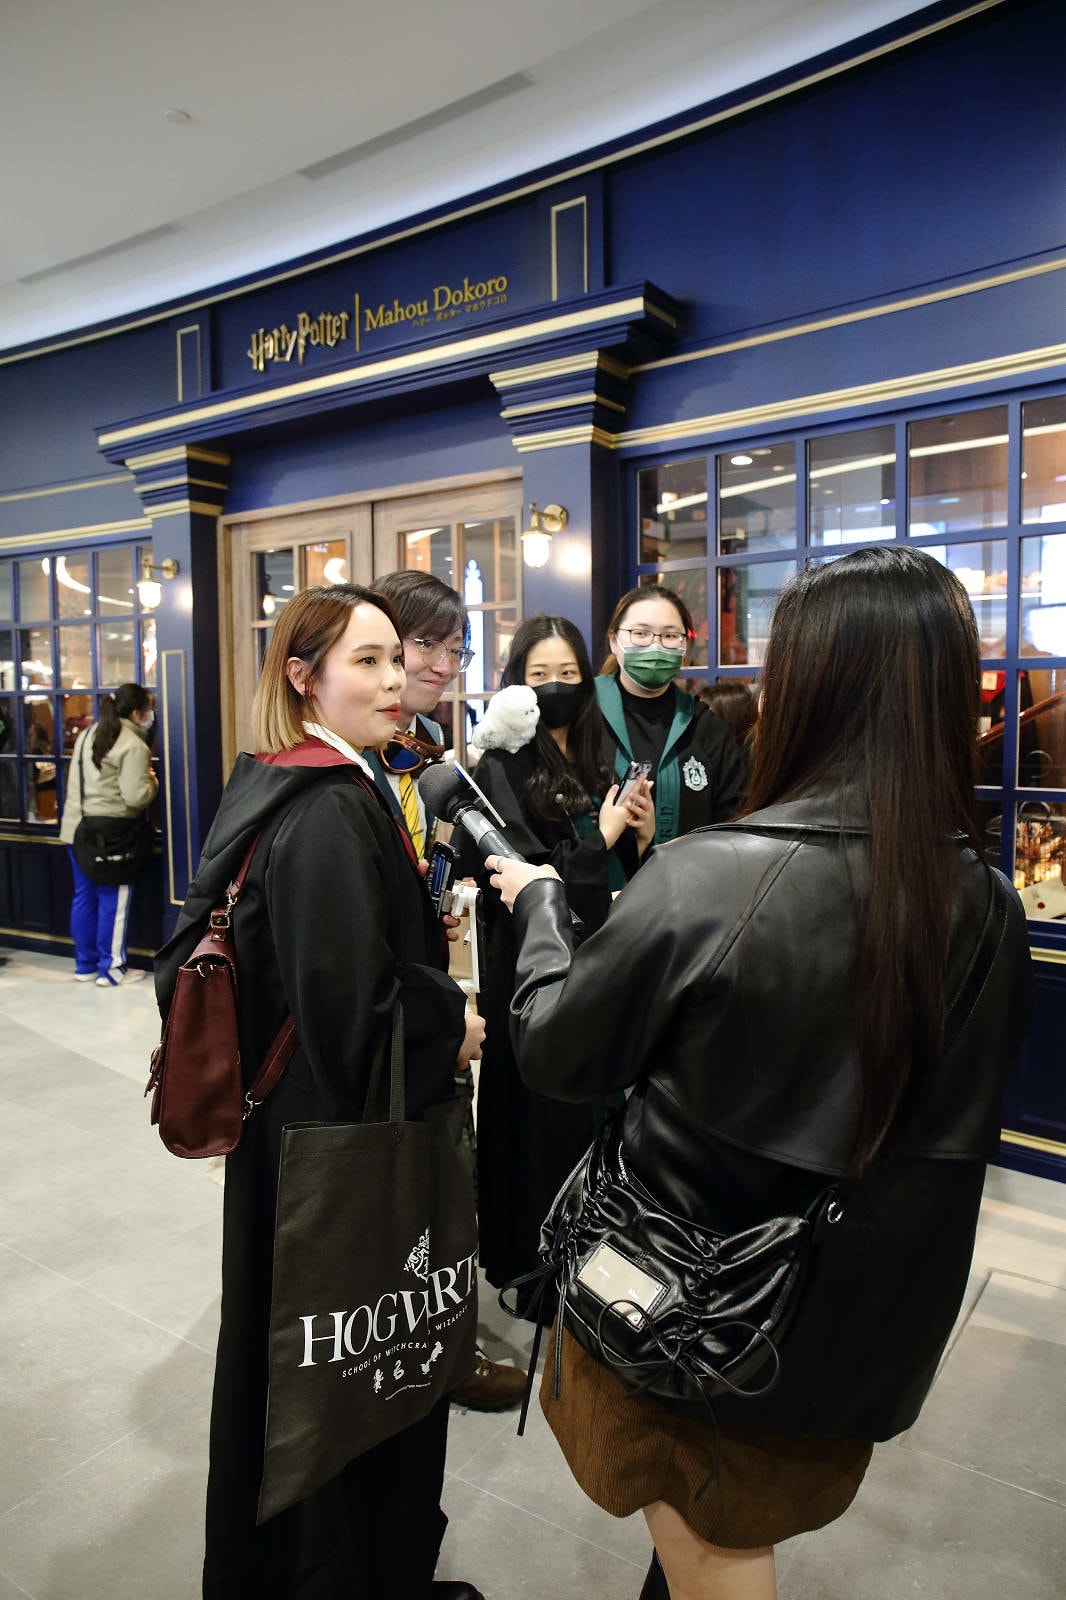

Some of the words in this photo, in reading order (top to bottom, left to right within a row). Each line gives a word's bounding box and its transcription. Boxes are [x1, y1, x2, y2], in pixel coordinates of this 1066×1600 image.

[364, 299, 429, 331] Mahou
[433, 276, 508, 311] Dokoro
[373, 1353, 382, 1363] OF
